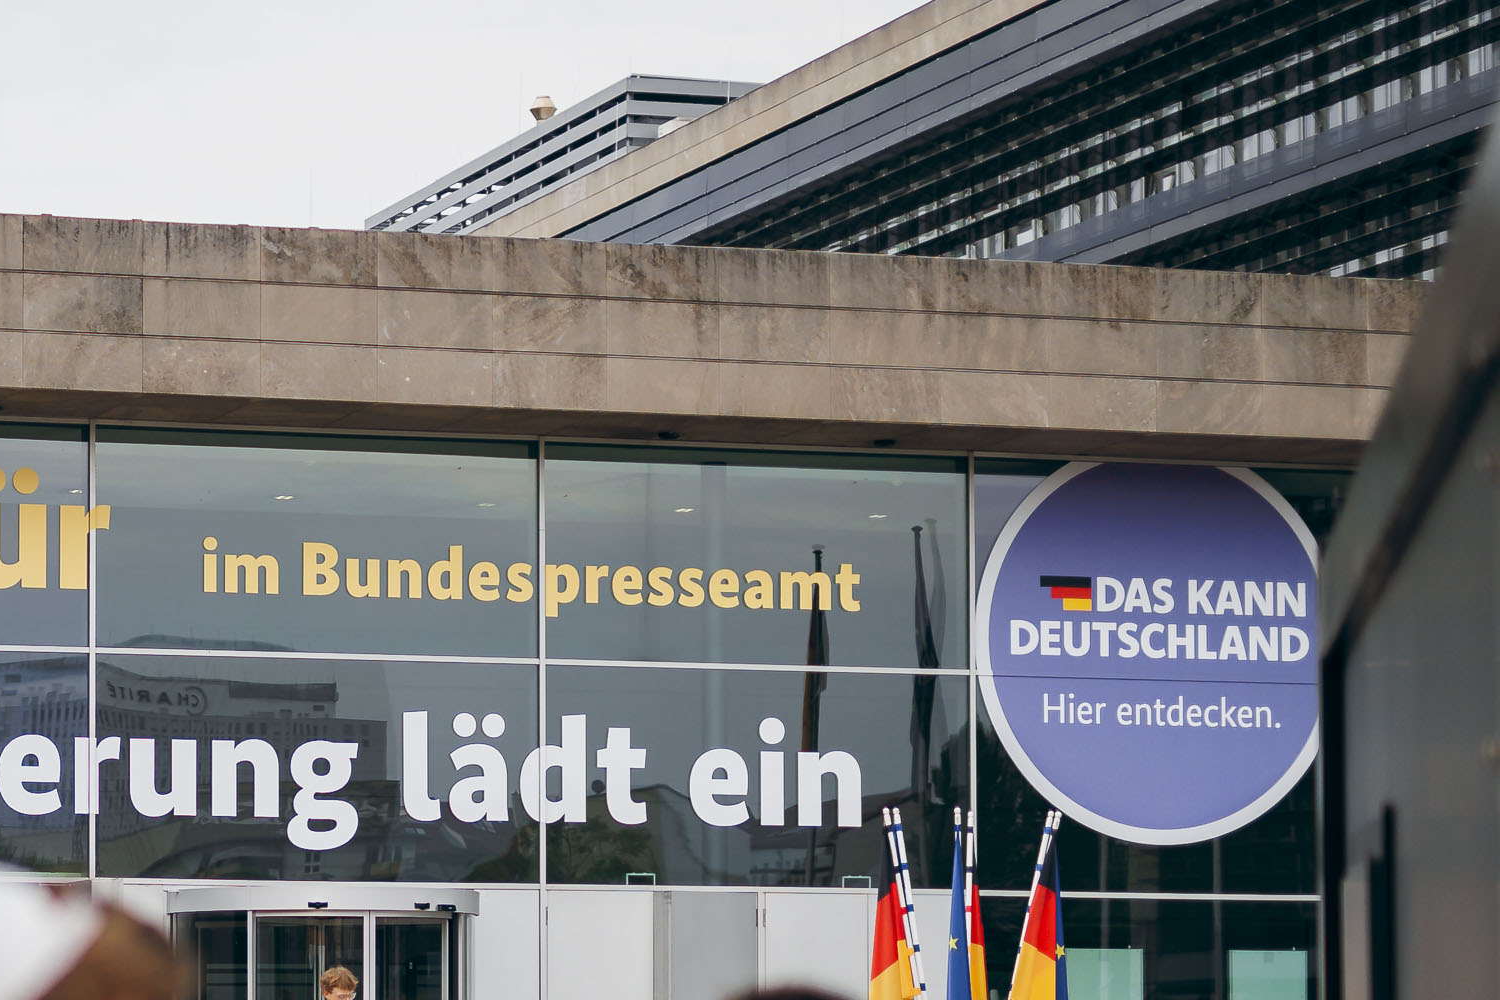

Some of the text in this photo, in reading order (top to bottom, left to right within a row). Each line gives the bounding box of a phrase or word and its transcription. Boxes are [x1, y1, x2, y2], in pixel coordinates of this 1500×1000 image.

[202, 536, 861, 618] im Bundespresseamt
[1095, 576, 1307, 618] DAS KANN
[1010, 619, 1310, 663] DEUTSCHLAND
[1043, 692, 1283, 730] Hier entdecken.
[403, 710, 647, 825] lädt
[689, 716, 862, 828] ein
